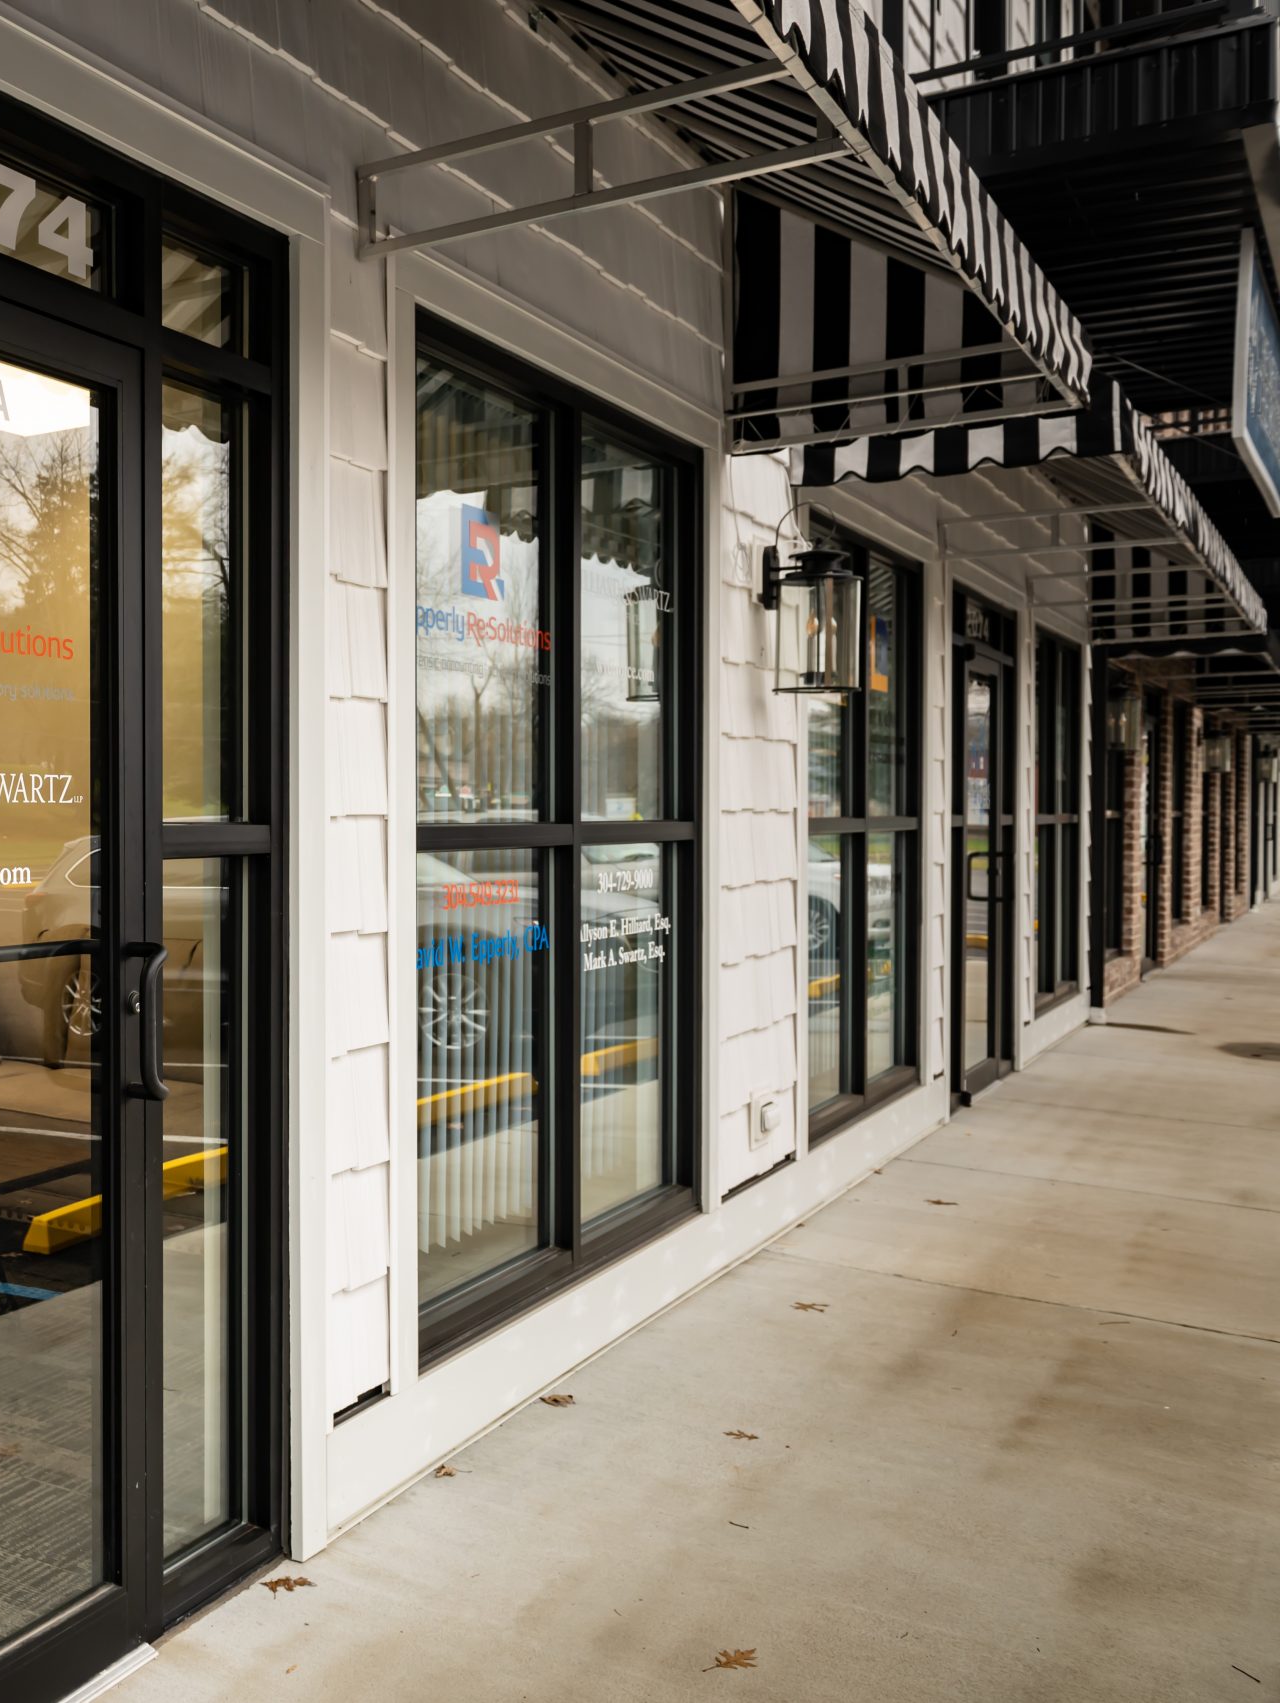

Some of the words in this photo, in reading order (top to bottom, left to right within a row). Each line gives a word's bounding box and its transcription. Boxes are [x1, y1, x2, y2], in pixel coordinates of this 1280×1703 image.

[416, 604, 465, 642] pperly
[597, 868, 654, 894] 304-729-9000
[416, 936, 446, 970] avid
[448, 933, 466, 965] W.
[471, 928, 520, 966] Epperly,
[523, 923, 551, 953] CPA
[580, 922, 608, 948] llyson
[609, 919, 619, 938] E.
[621, 914, 653, 936] Hilliard,
[654, 912, 672, 935] Esq.
[583, 949, 607, 972] Mark
[607, 947, 618, 968] A.
[618, 945, 647, 965] Swartz,
[648, 940, 666, 963] Esq.
